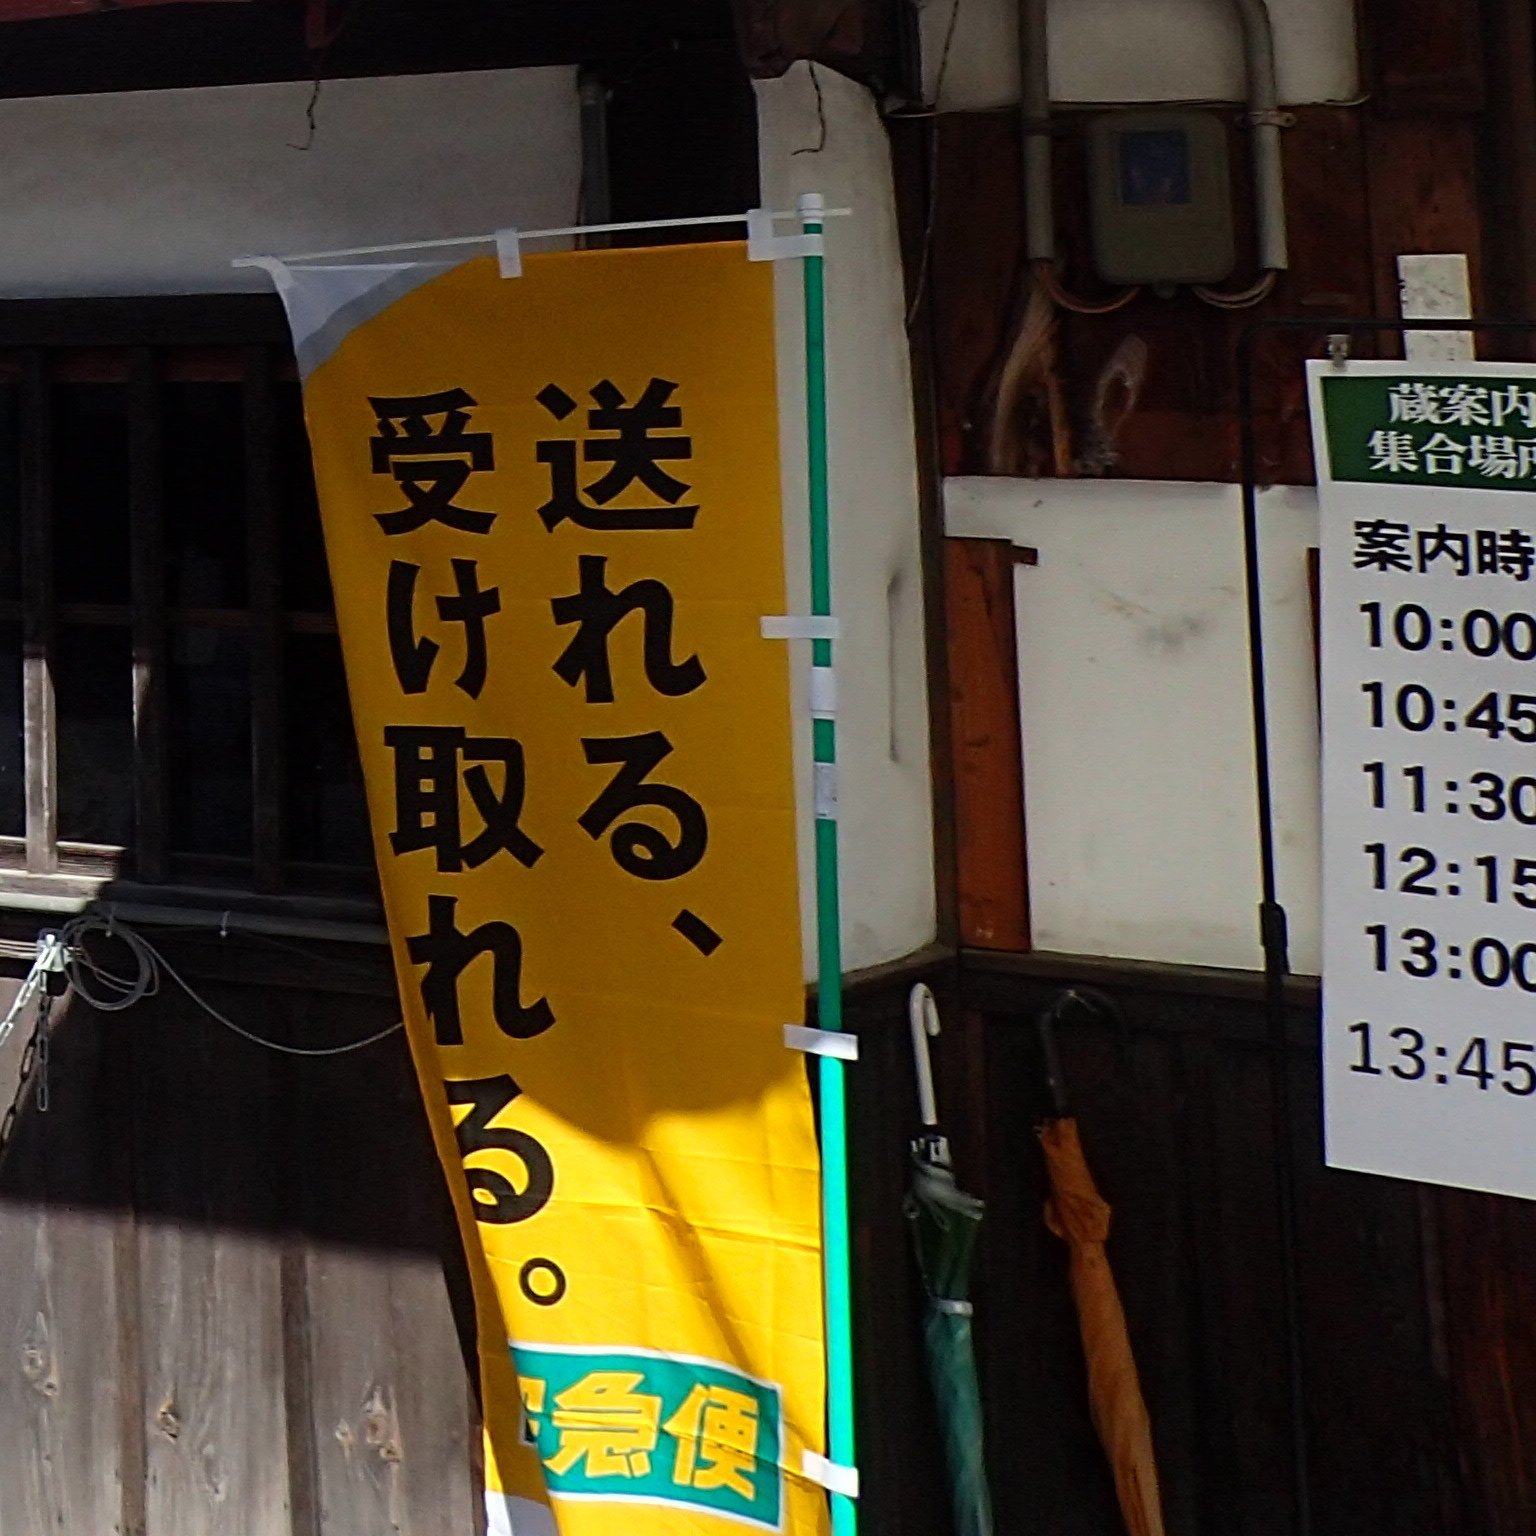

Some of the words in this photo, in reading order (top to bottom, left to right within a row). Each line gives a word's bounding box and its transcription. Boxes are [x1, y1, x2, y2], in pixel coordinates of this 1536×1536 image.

[1387, 382, 1536, 429] 蔵案内
[1352, 519, 1535, 582] 案内時
[1359, 601, 1536, 661] 10:00
[535, 377, 724, 957] 送れる、
[1361, 681, 1536, 743] 10:45
[1362, 761, 1536, 826] 11:30
[367, 386, 568, 1308] 受け取れる。
[1363, 842, 1536, 909] 12:15
[1364, 924, 1536, 993] 13:00
[1348, 1021, 1536, 1096] 13:45
